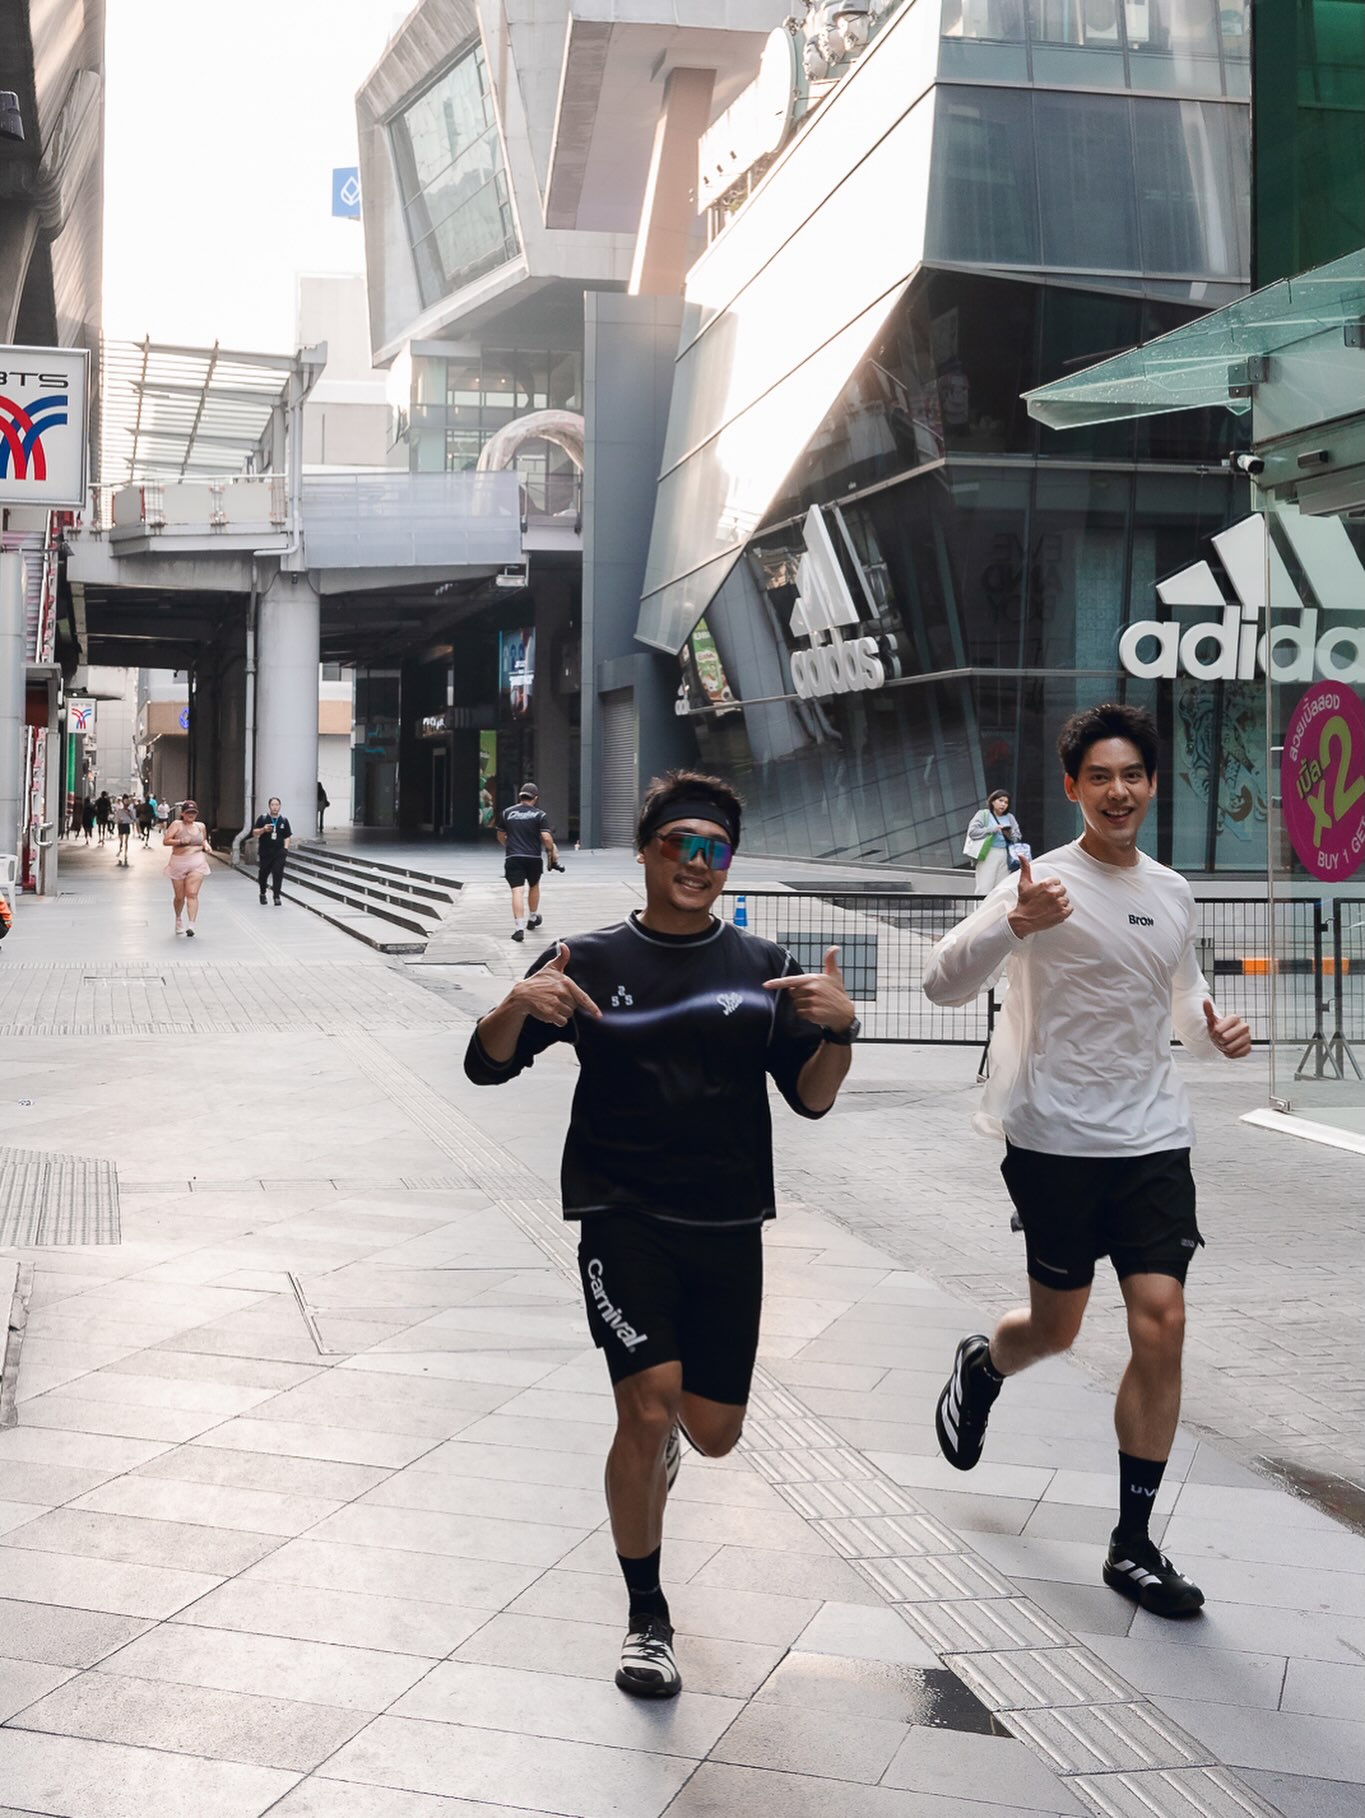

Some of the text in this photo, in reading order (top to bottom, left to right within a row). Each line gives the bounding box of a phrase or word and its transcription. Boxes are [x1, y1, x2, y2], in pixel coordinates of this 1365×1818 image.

[0, 371, 69, 388] TS
[790, 627, 885, 700] adidas
[1317, 850, 1339, 870] BUY
[1342, 848, 1350, 864] 1
